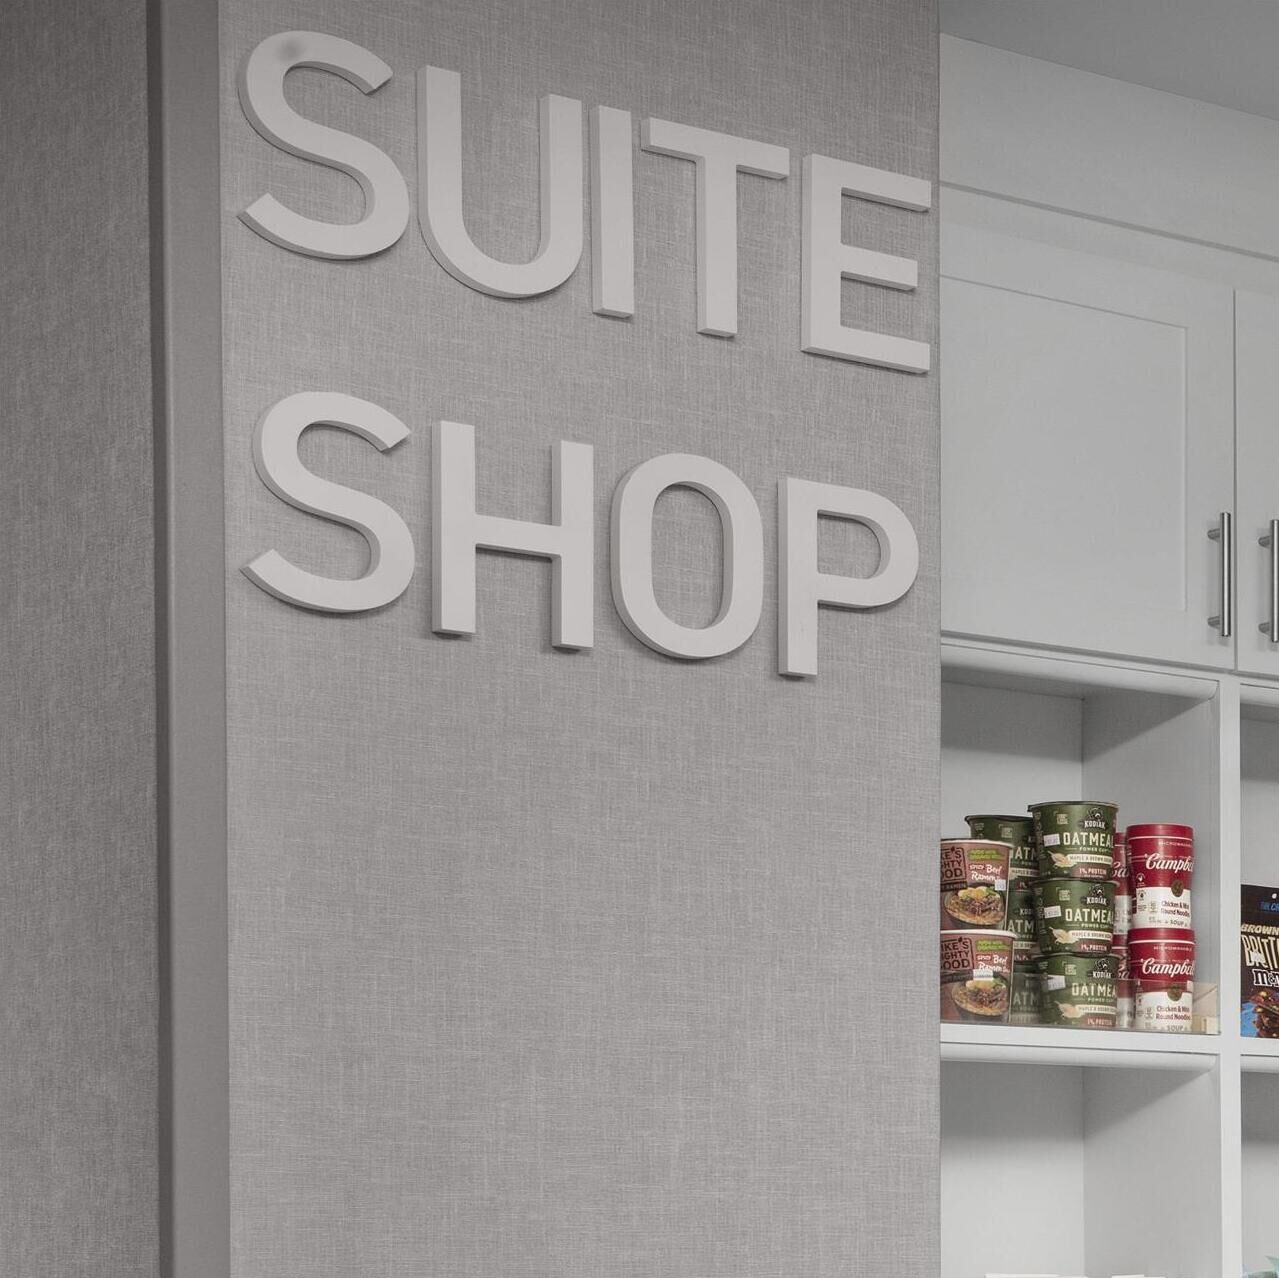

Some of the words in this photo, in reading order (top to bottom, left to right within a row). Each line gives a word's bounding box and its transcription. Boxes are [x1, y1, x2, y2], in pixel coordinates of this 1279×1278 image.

[236, 30, 931, 376] SUITE
[239, 391, 921, 679] SHOP
[1071, 982, 1116, 997] OATMEA
